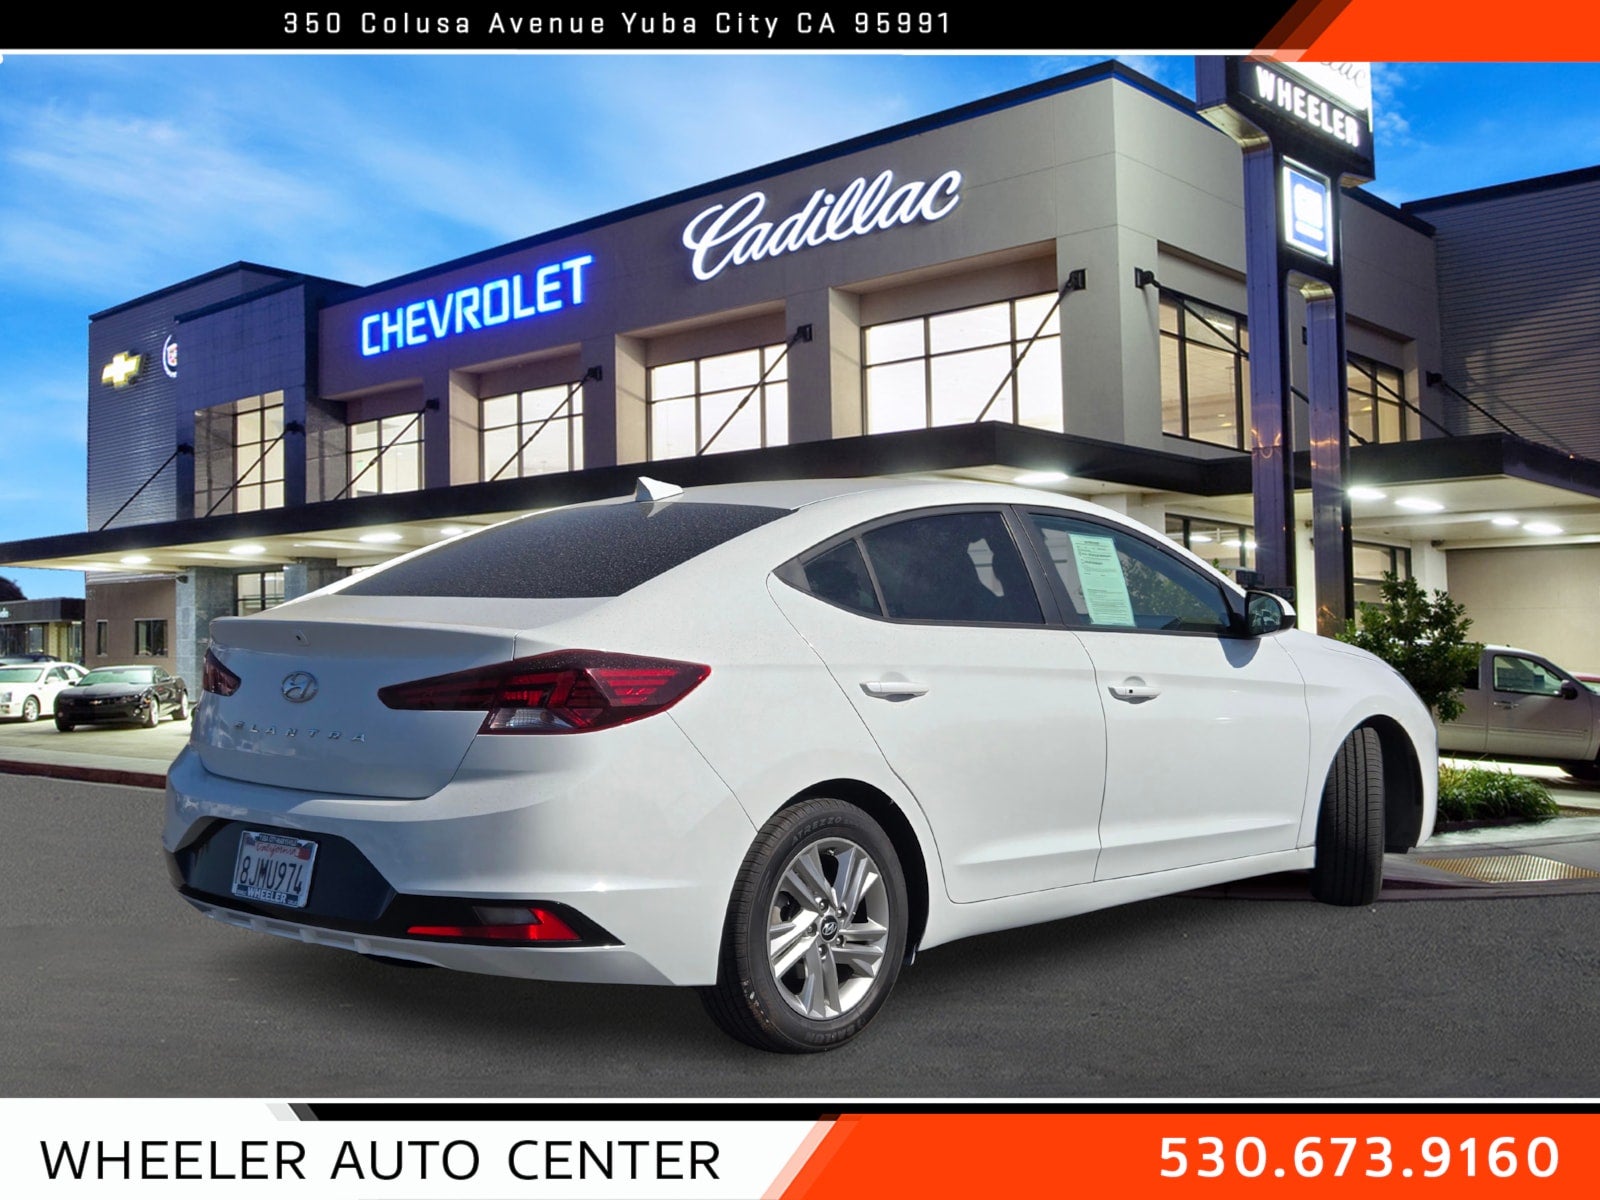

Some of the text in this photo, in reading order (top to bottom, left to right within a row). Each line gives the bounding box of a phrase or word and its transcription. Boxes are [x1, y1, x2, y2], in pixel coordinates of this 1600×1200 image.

[1254, 66, 1360, 148] WHEELER
[682, 169, 962, 281] Cadillac
[361, 254, 593, 357] CHEVROLET
[234, 720, 366, 743] ELANTRA
[240, 855, 303, 894] 8JMU974
[246, 886, 288, 903] WHEELER
